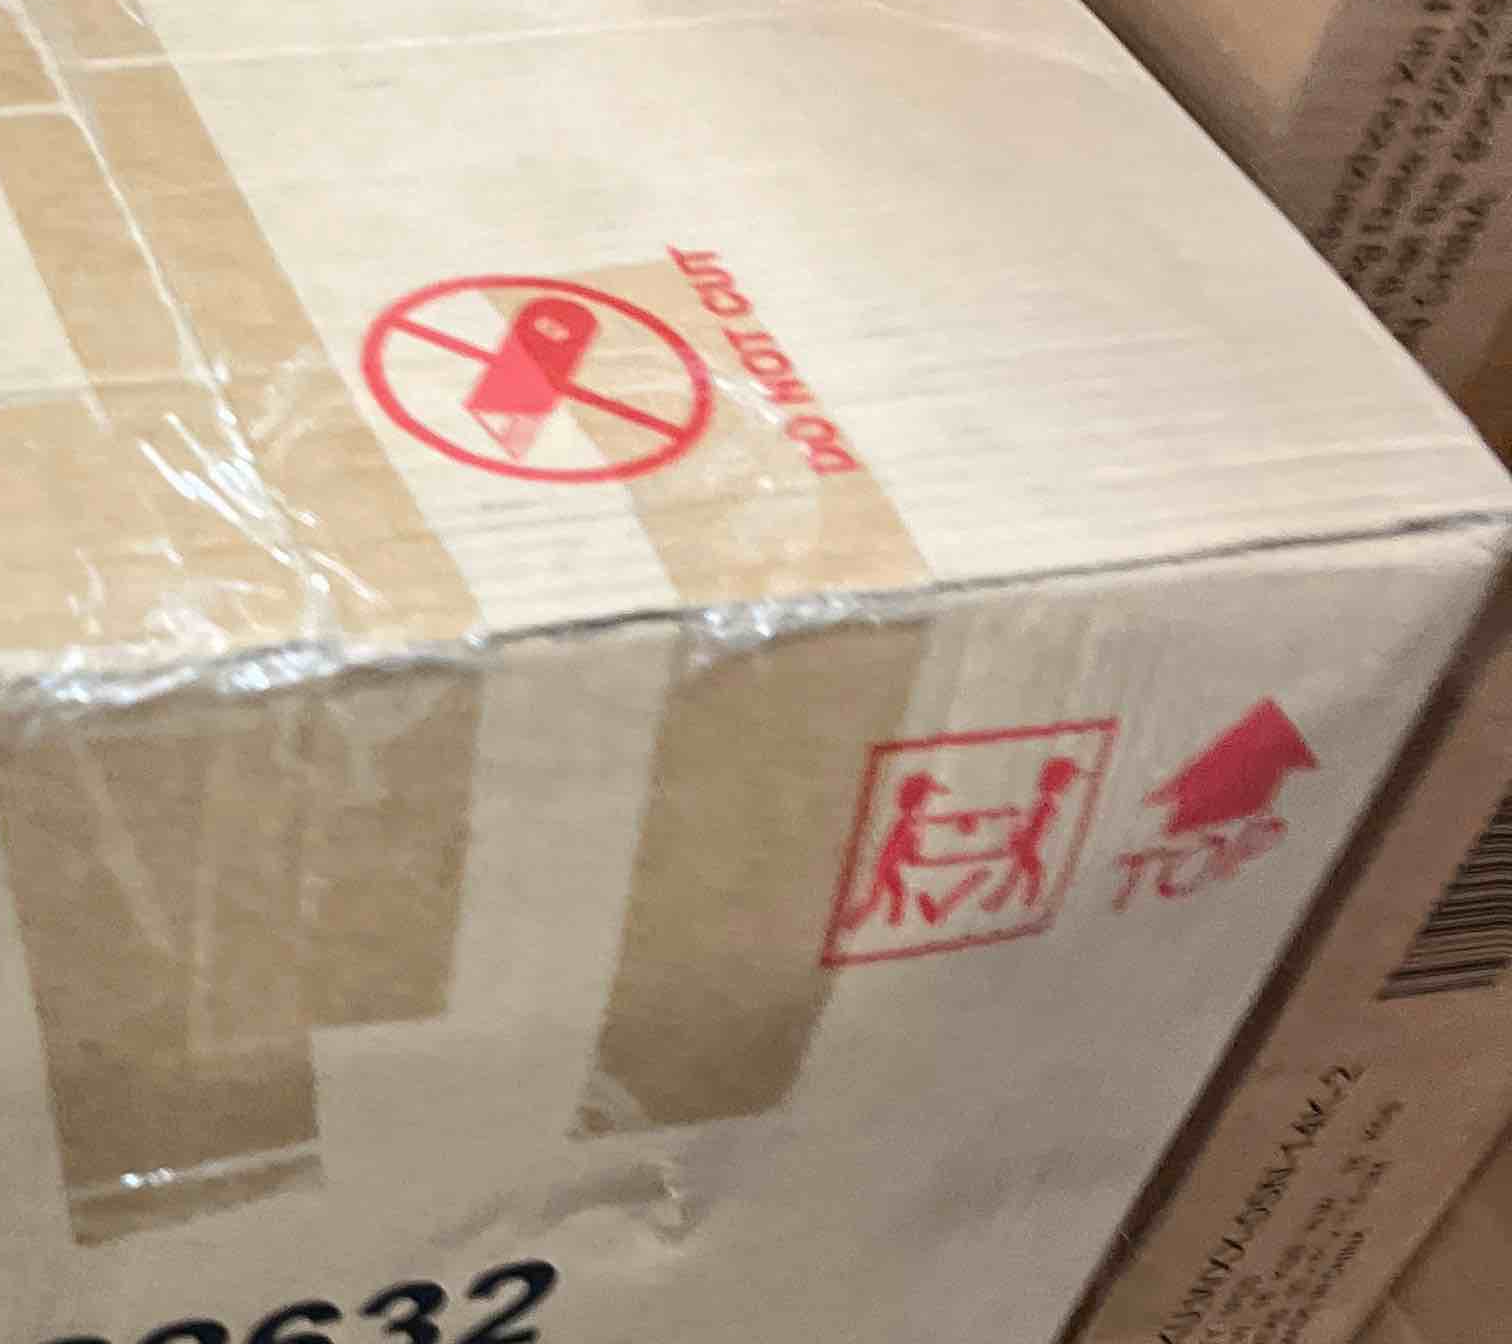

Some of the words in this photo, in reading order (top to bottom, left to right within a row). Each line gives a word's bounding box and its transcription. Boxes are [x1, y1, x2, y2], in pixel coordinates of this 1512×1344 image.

[666, 244, 753, 319] CUT
[722, 327, 815, 405] NOT
[786, 415, 864, 475] DO
[1111, 817, 1286, 913] TOP
